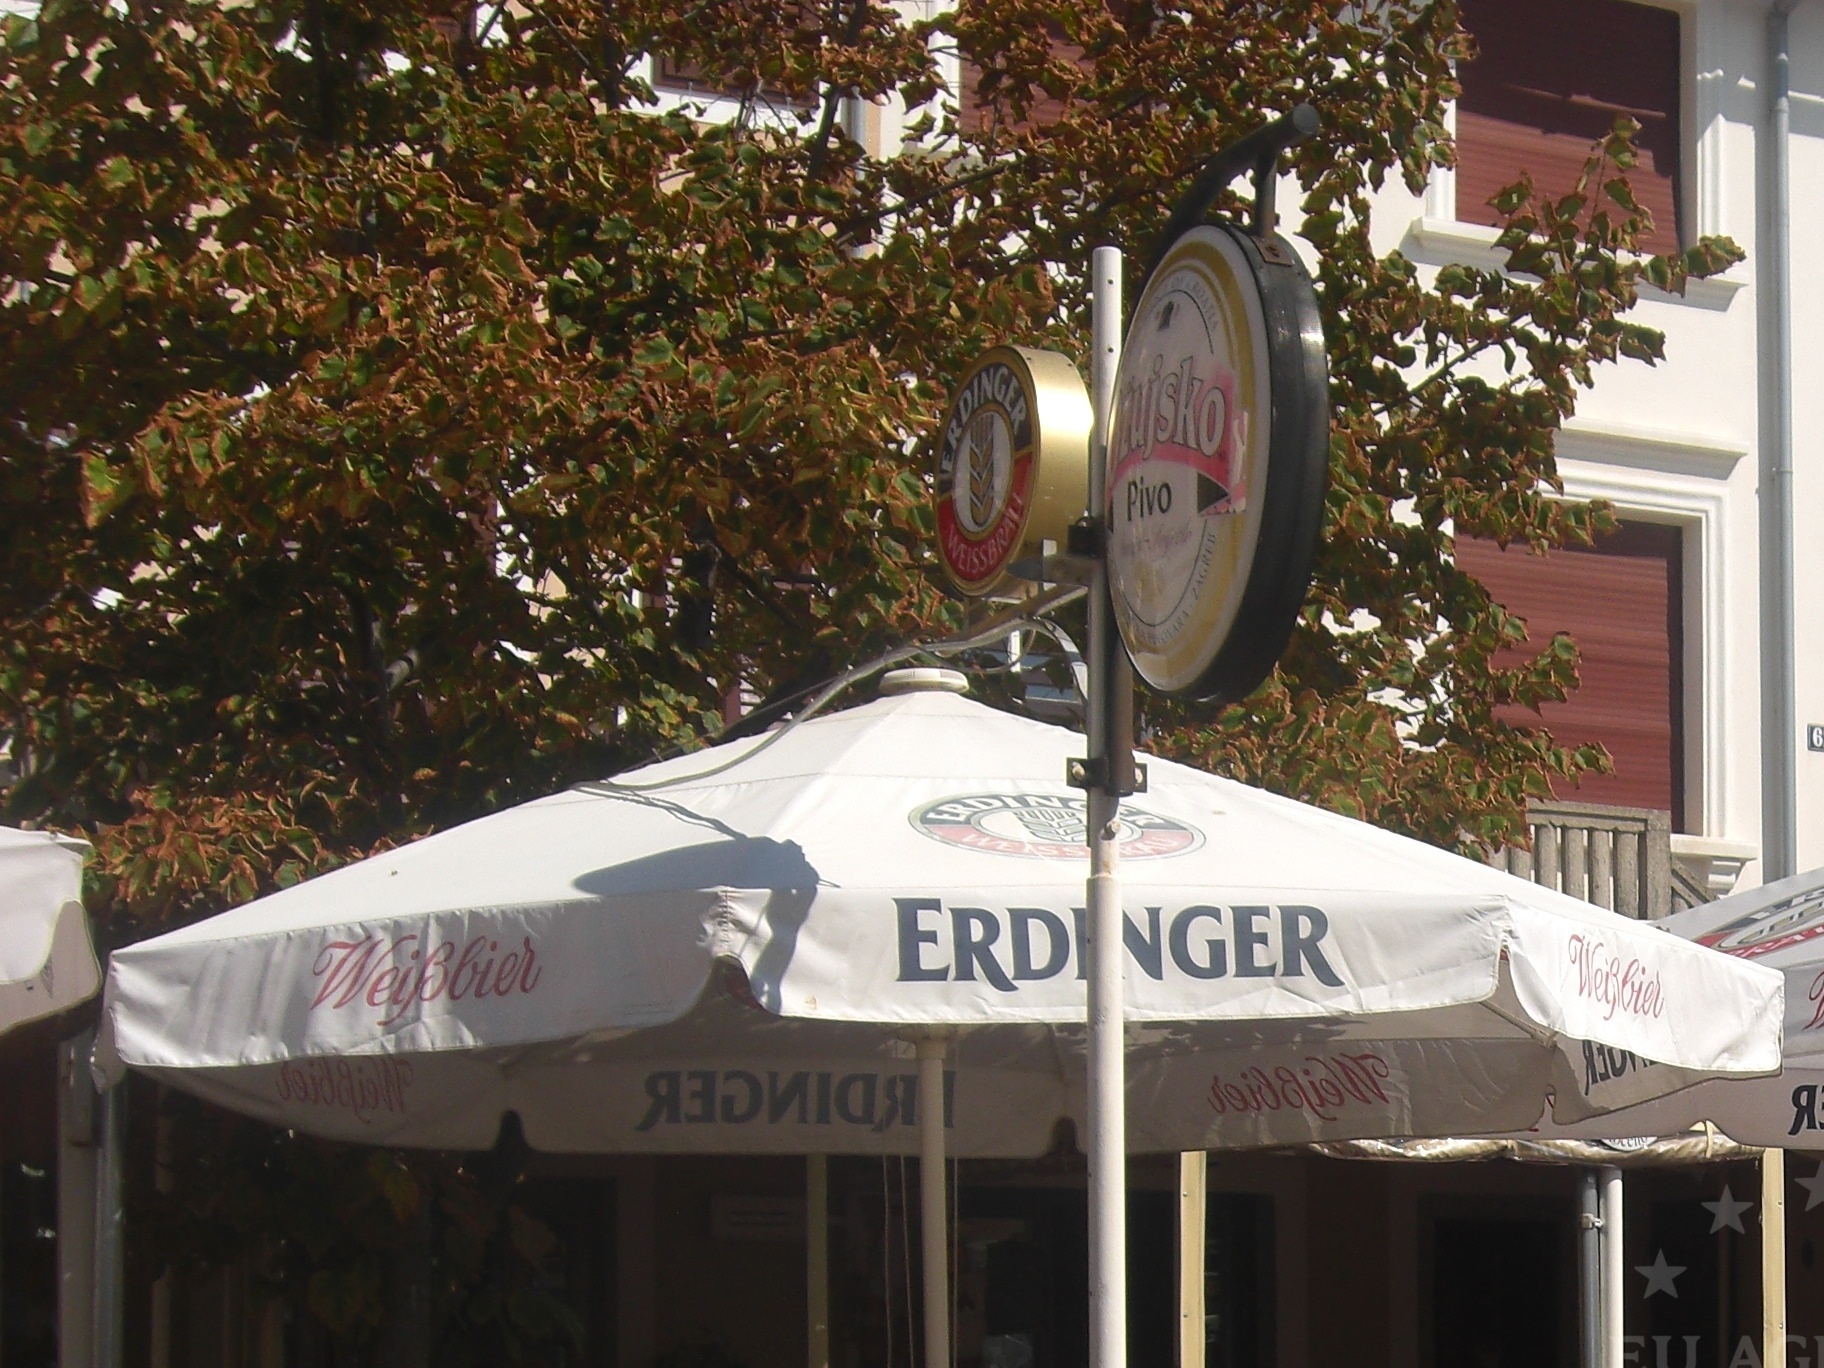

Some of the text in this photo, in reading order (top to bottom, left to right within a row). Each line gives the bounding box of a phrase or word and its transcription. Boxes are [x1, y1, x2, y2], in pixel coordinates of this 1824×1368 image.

[942, 365, 1027, 471] ERDINGER
[1127, 475, 1173, 522] Pivo
[313, 934, 541, 1026] Weißbier
[1568, 933, 1664, 1020] Weißbier
